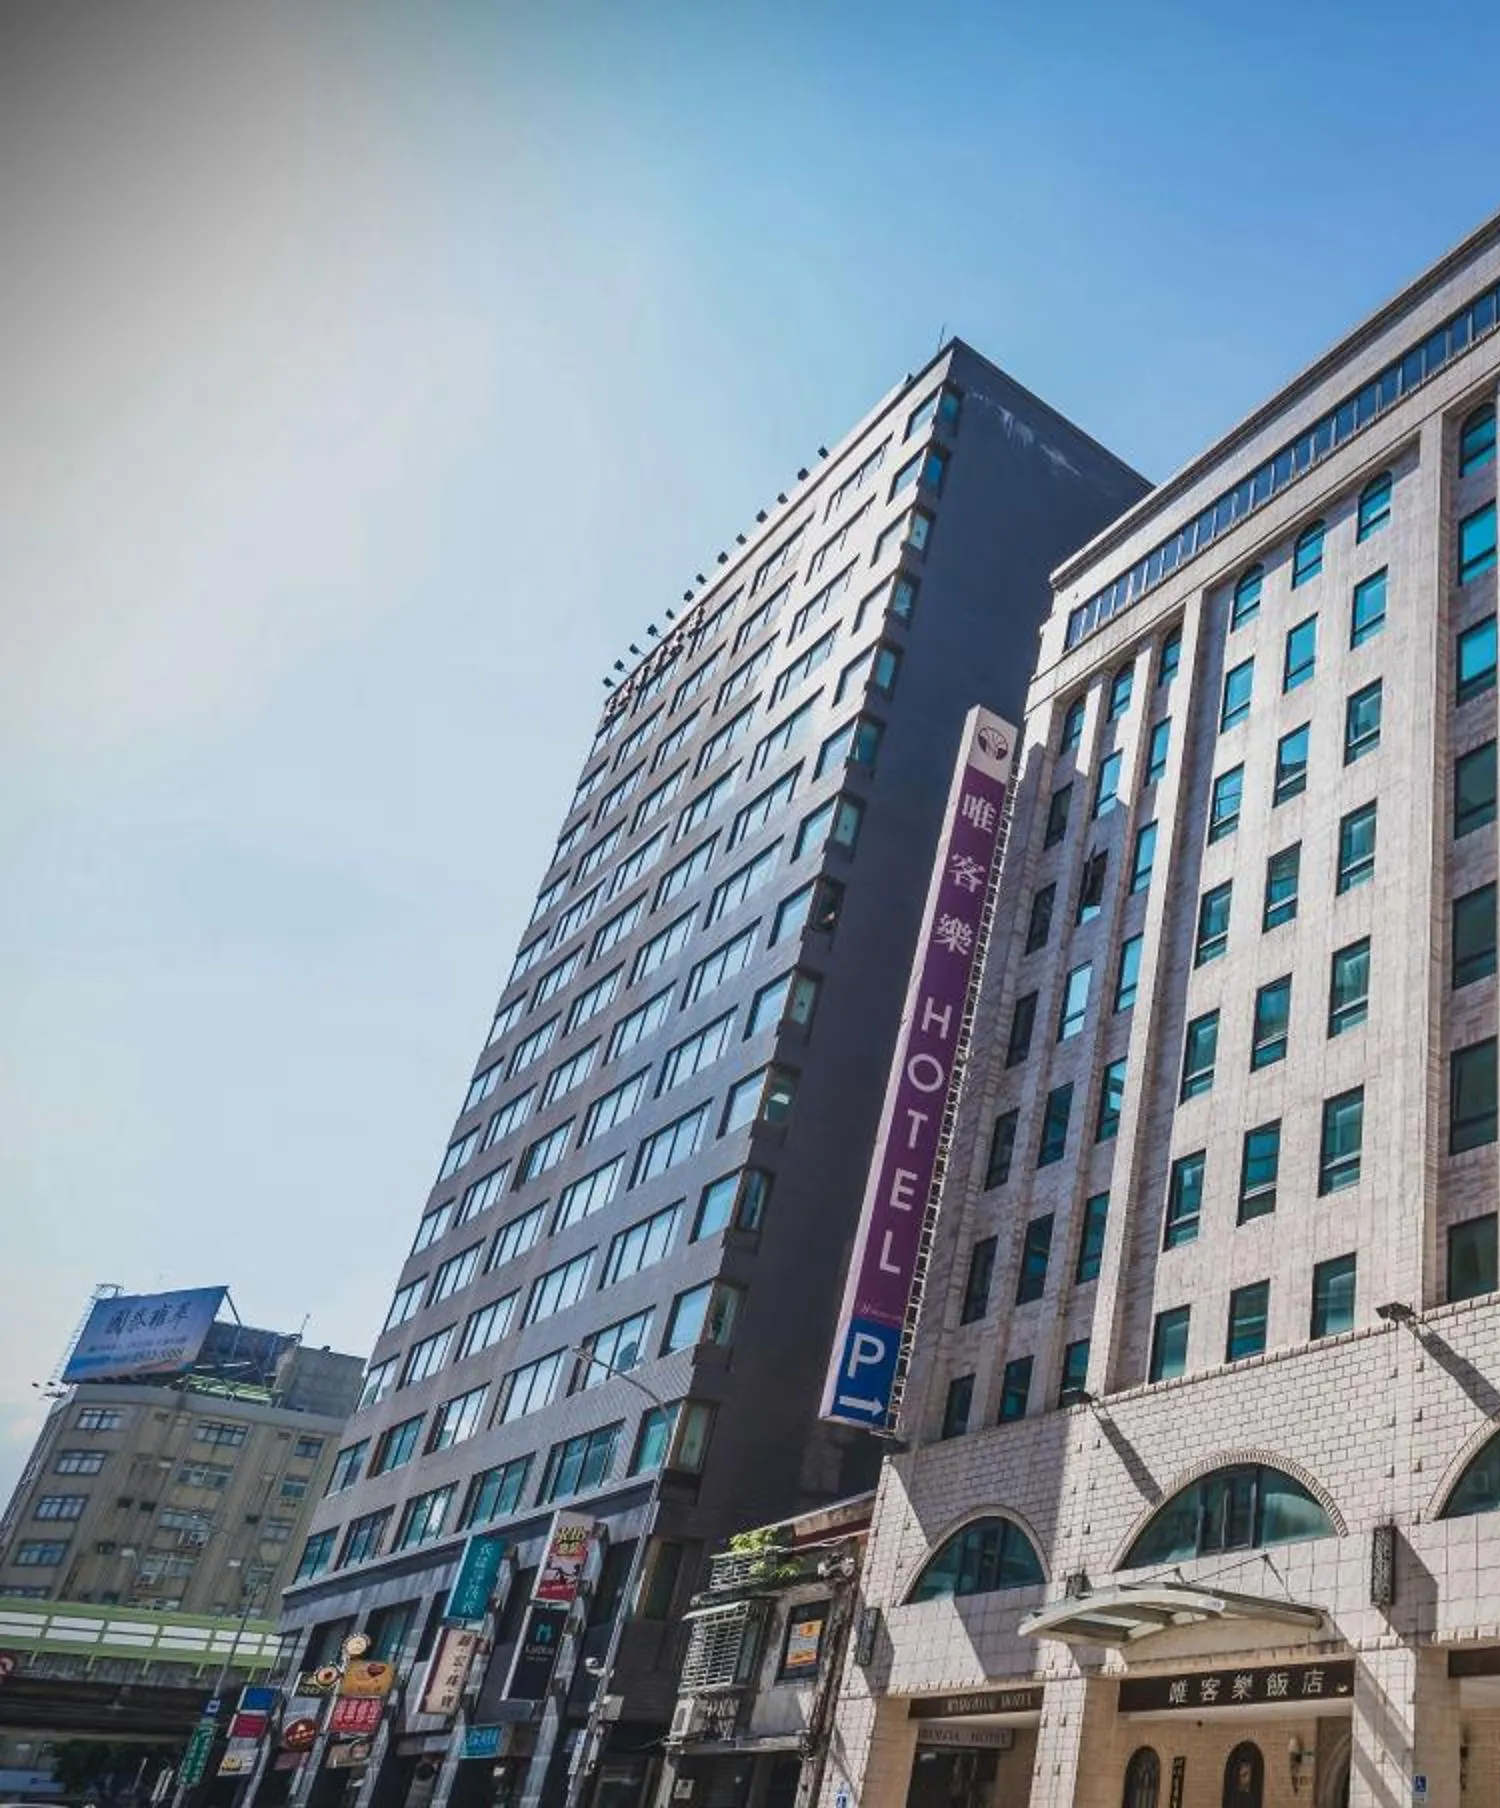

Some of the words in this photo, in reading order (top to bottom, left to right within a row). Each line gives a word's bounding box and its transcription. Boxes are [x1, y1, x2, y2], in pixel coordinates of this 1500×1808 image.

[932, 792, 998, 955] 唯客樂
[880, 997, 953, 1275] HOTEL
[846, 1332, 885, 1379] P
[1168, 1669, 1325, 1704] 唯客樂飯店
